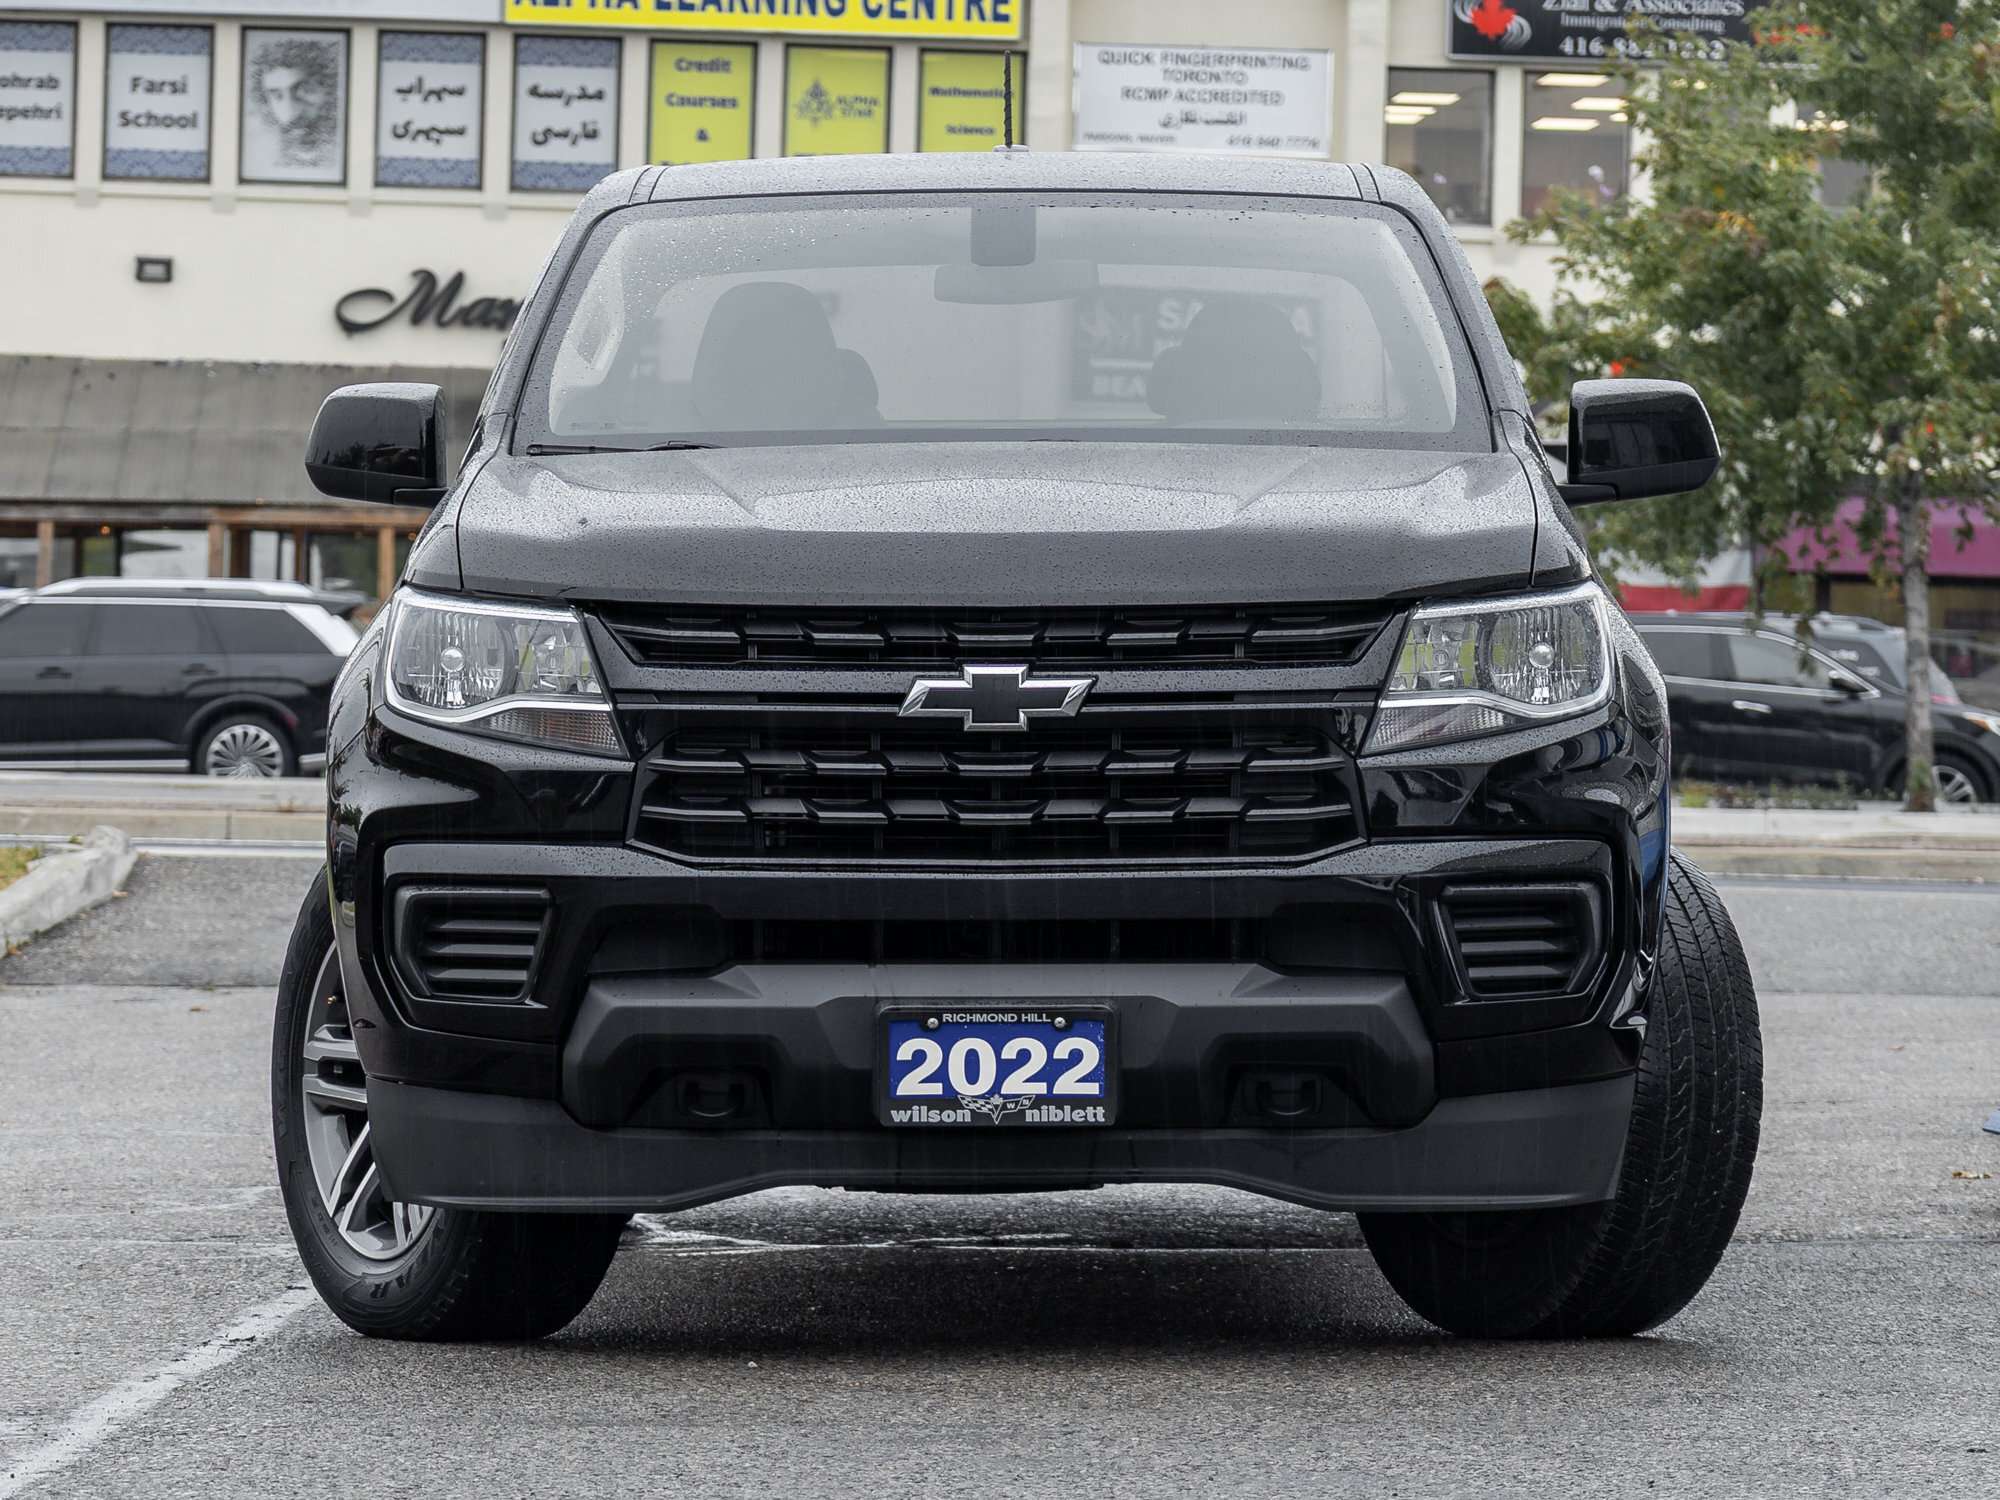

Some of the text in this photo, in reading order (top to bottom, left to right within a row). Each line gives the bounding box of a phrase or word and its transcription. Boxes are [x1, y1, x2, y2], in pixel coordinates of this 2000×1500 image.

[674, 58, 731, 73] Credit
[0, 73, 60, 90] ohrab
[130, 75, 188, 95] Farsi
[528, 84, 606, 107] مدرسه
[0, 103, 62, 122] epehri
[118, 110, 198, 129] School
[531, 121, 599, 146] فارسی
[942, 1013, 1051, 1023] RICHMOND HILL
[896, 1037, 1100, 1096] 2022
[890, 1105, 1105, 1123] wilson niblett
